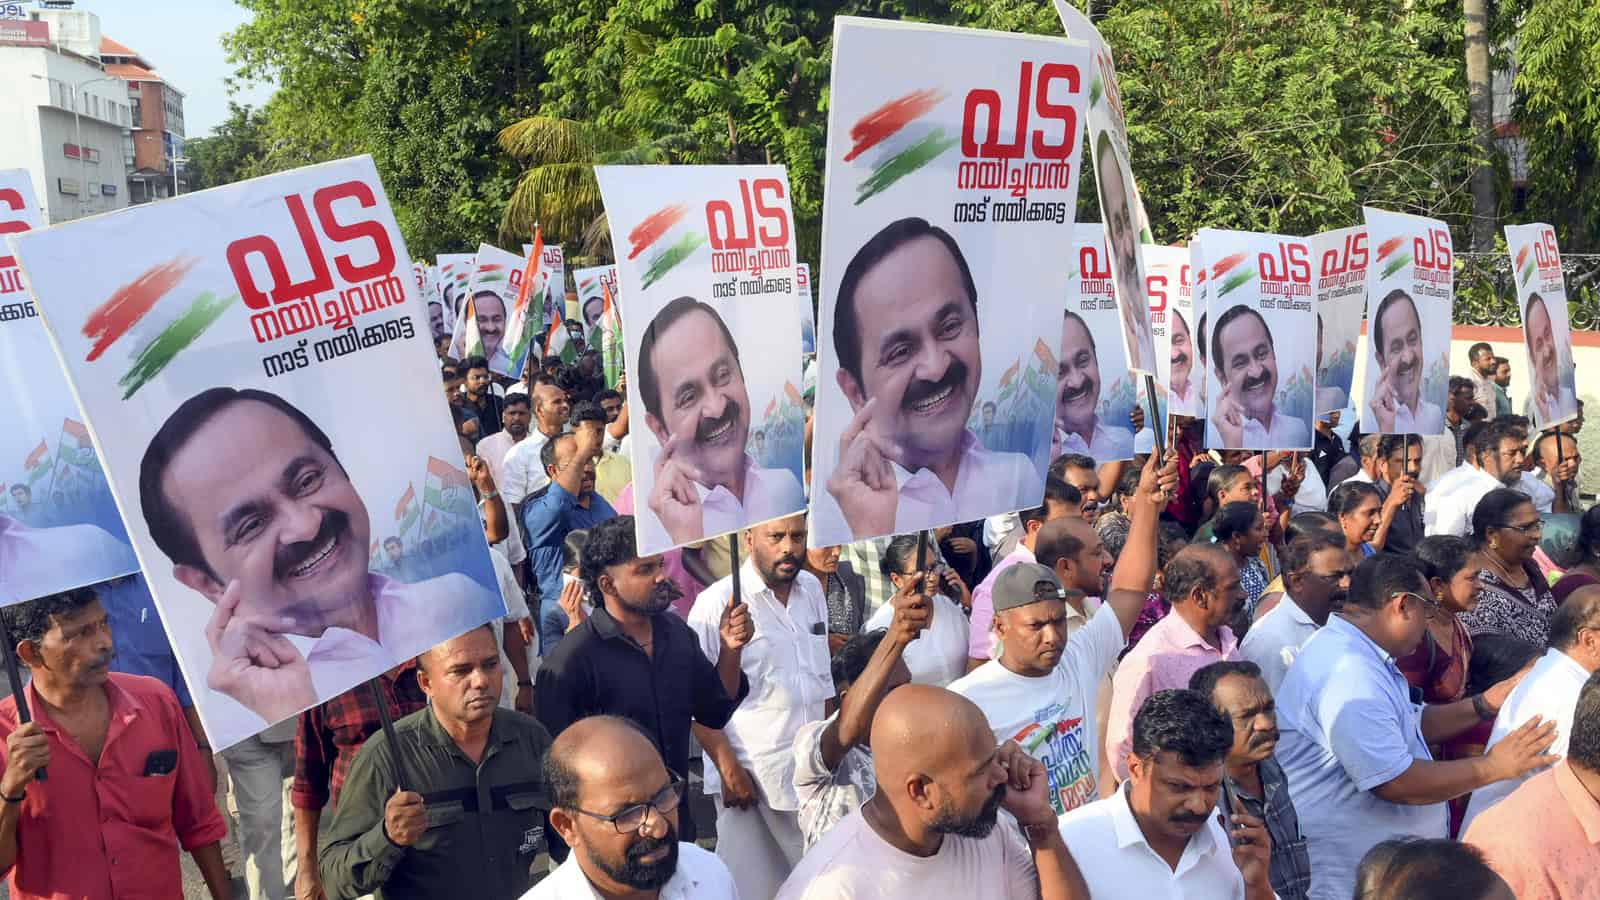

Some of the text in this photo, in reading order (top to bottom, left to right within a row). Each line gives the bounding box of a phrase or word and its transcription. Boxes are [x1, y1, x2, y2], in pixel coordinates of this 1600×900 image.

[960, 61, 1080, 159] പട
[957, 159, 1070, 197] നയിച്ചവൻ
[705, 178, 789, 250] പട
[953, 196, 1066, 223] നാട് നയിക്കട്ടെ
[226, 180, 396, 310] പട
[711, 247, 791, 276] നയിച്ചവൻ
[1080, 238, 1112, 279] പ
[1258, 242, 1311, 283] പട
[1321, 232, 1369, 277] പട
[1414, 228, 1451, 271] പട
[1535, 230, 1559, 268] പട
[713, 275, 792, 298] നാട് നയിക്കട്ടെ
[1146, 275, 1168, 312] ട
[250, 274, 405, 344] നയിച്ചവൻ
[262, 316, 415, 378] നാട് നയിക്കട്ടെ
